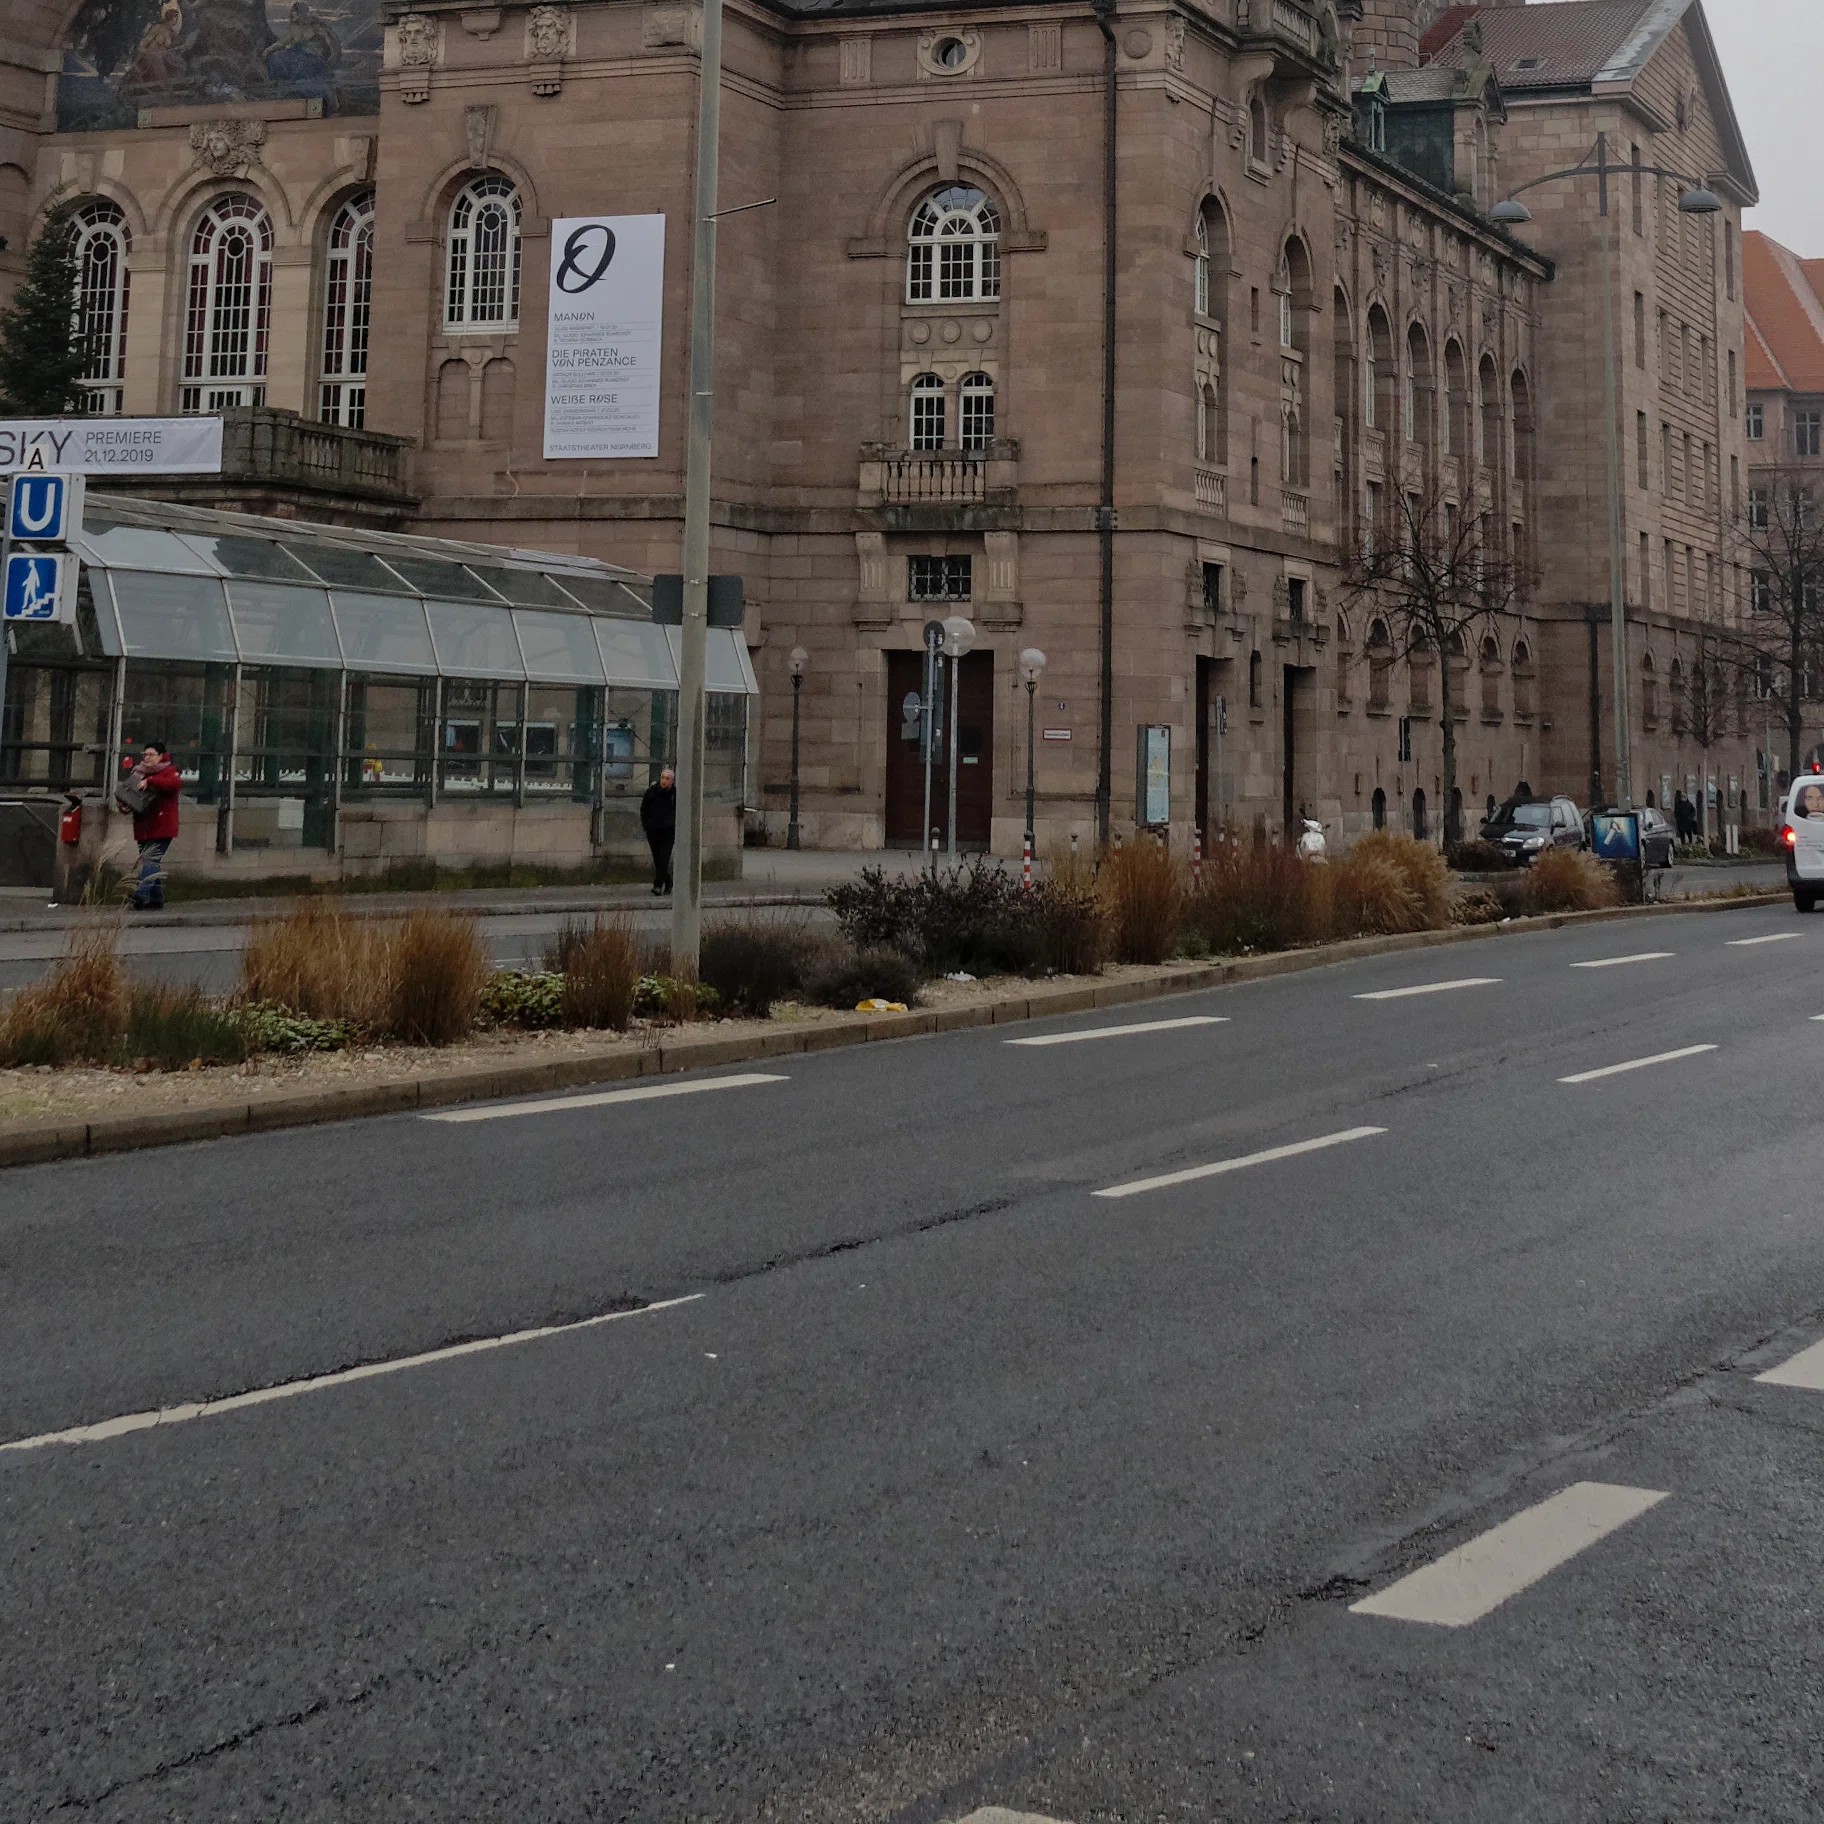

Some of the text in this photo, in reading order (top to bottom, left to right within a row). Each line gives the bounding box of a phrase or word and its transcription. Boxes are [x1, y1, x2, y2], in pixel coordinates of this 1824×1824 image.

[552, 348, 618, 358] DIE PIRATEN
[578, 356, 637, 367] PENZANCE
[85, 430, 162, 445] PREMIERE
[549, 443, 609, 452] STAATSTHEATER
[27, 447, 45, 470] A
[84, 448, 154, 463] 21.12.2019
[20, 482, 56, 532] U
